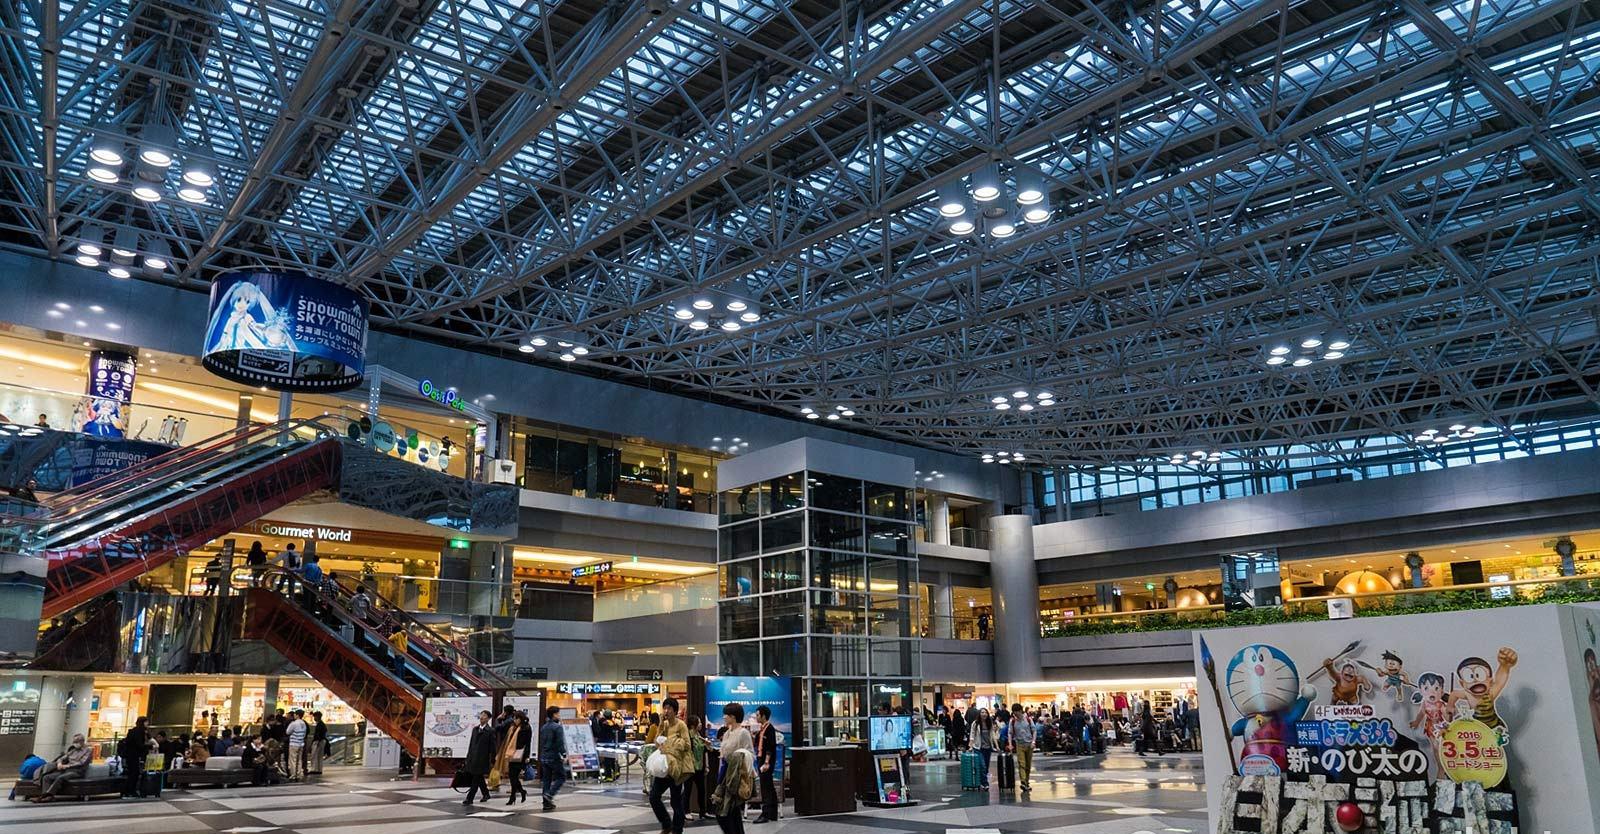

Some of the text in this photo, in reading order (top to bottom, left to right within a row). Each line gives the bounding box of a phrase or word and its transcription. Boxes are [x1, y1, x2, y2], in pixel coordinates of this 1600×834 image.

[420, 379, 446, 403] Oasis
[261, 523, 352, 542] Gourmet World
[1315, 705, 1331, 717] 4F
[1297, 719, 1398, 747] 映画 ドラえもん
[1457, 731, 1481, 740] 2016
[1447, 760, 1503, 769] ロードショー
